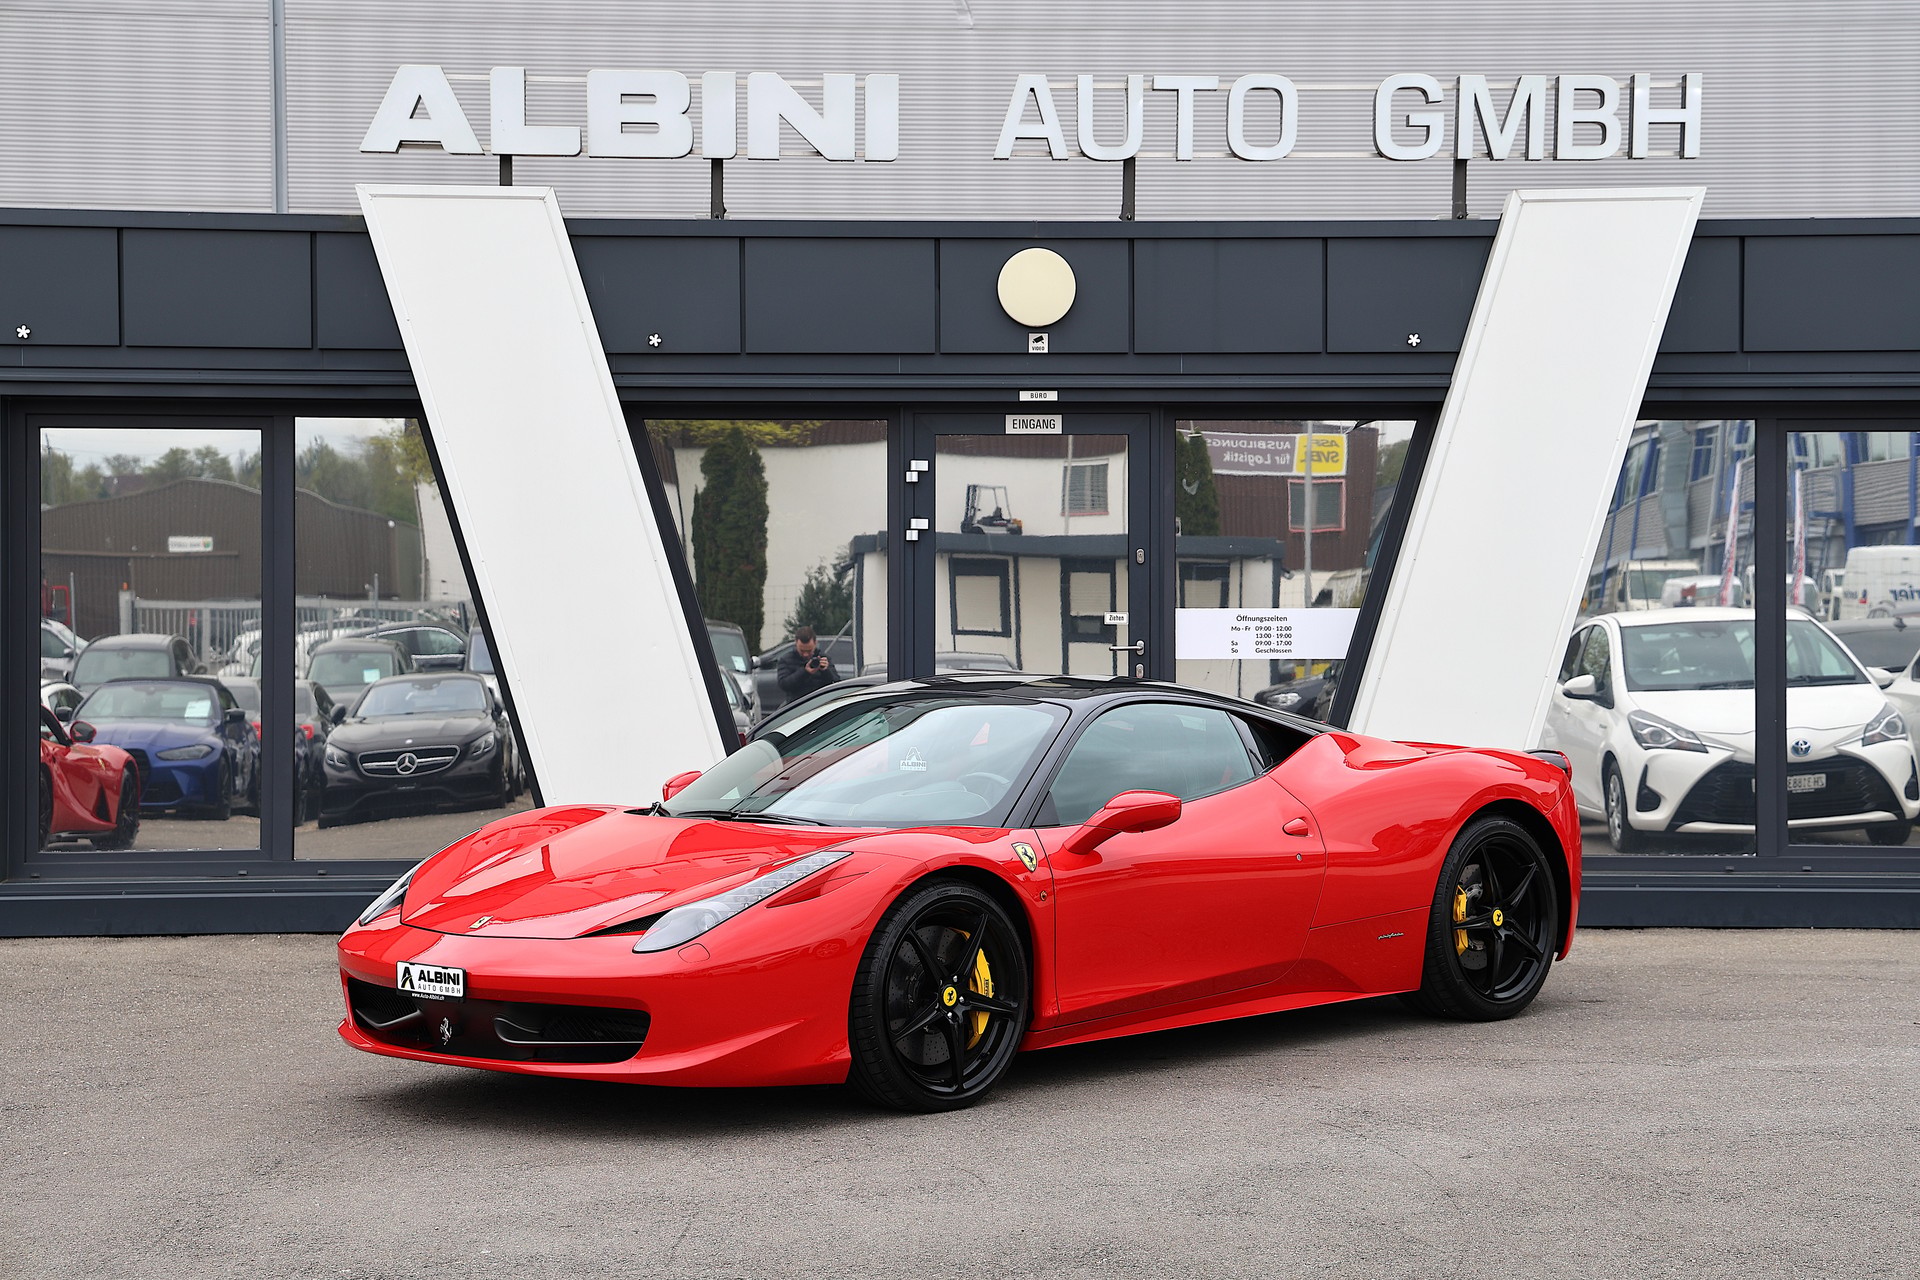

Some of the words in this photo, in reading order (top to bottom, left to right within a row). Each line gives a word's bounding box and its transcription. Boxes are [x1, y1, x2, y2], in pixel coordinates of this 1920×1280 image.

[359, 64, 900, 162] ALBINI
[992, 73, 1300, 162] AUTO
[1374, 72, 1704, 162] GMBH
[1012, 418, 1056, 430] EINGANG
[1235, 614, 1288, 623] Öffnungszeiten
[418, 969, 460, 986] ALBINI
[417, 983, 437, 992] AUTO
[440, 985, 461, 994] GMBH
